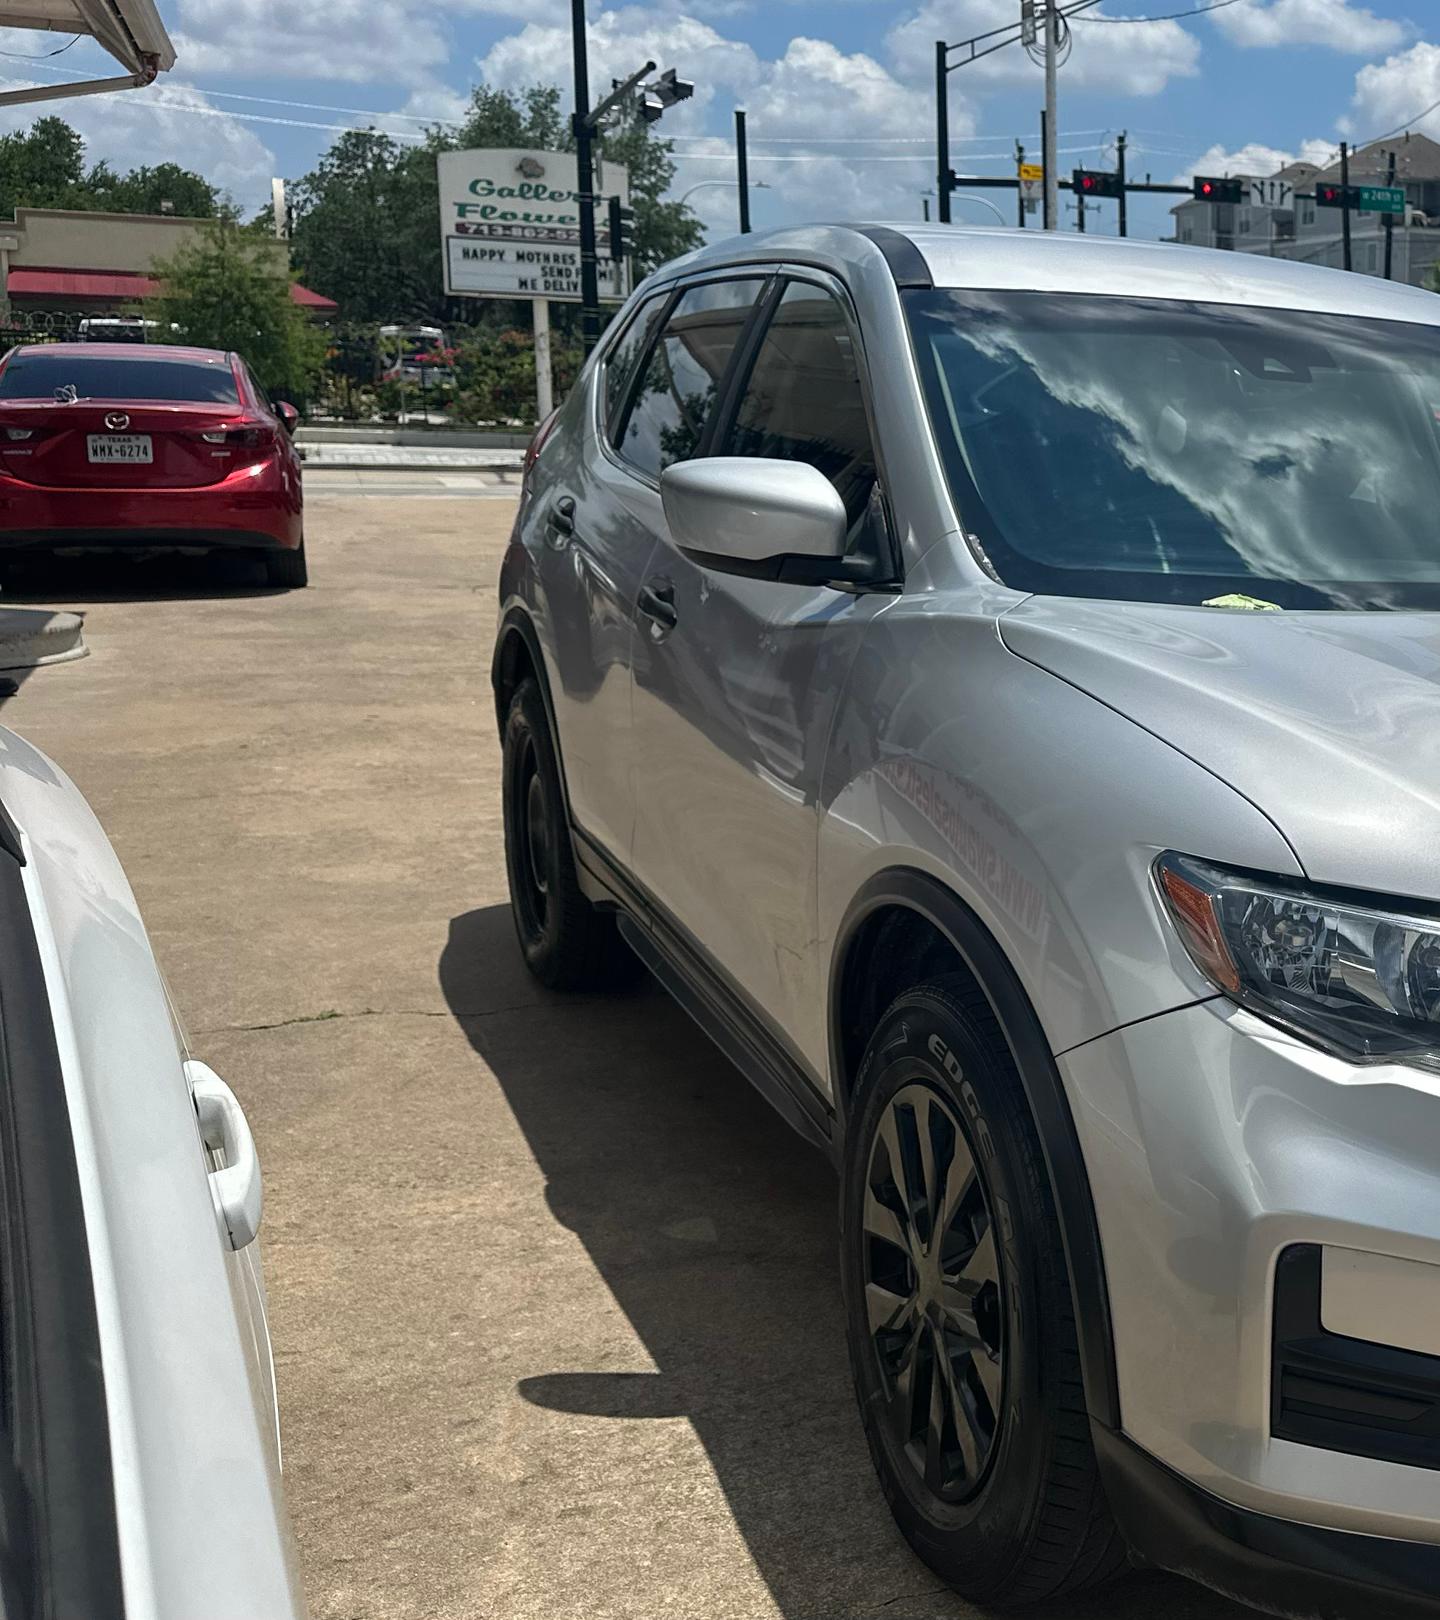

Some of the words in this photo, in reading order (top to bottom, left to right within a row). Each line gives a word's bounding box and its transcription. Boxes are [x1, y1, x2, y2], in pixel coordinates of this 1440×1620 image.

[466, 224, 605, 242] 713-862-527
[462, 247, 505, 261] HAPPY
[541, 265, 572, 279] SEND
[543, 278, 581, 292] DELIV
